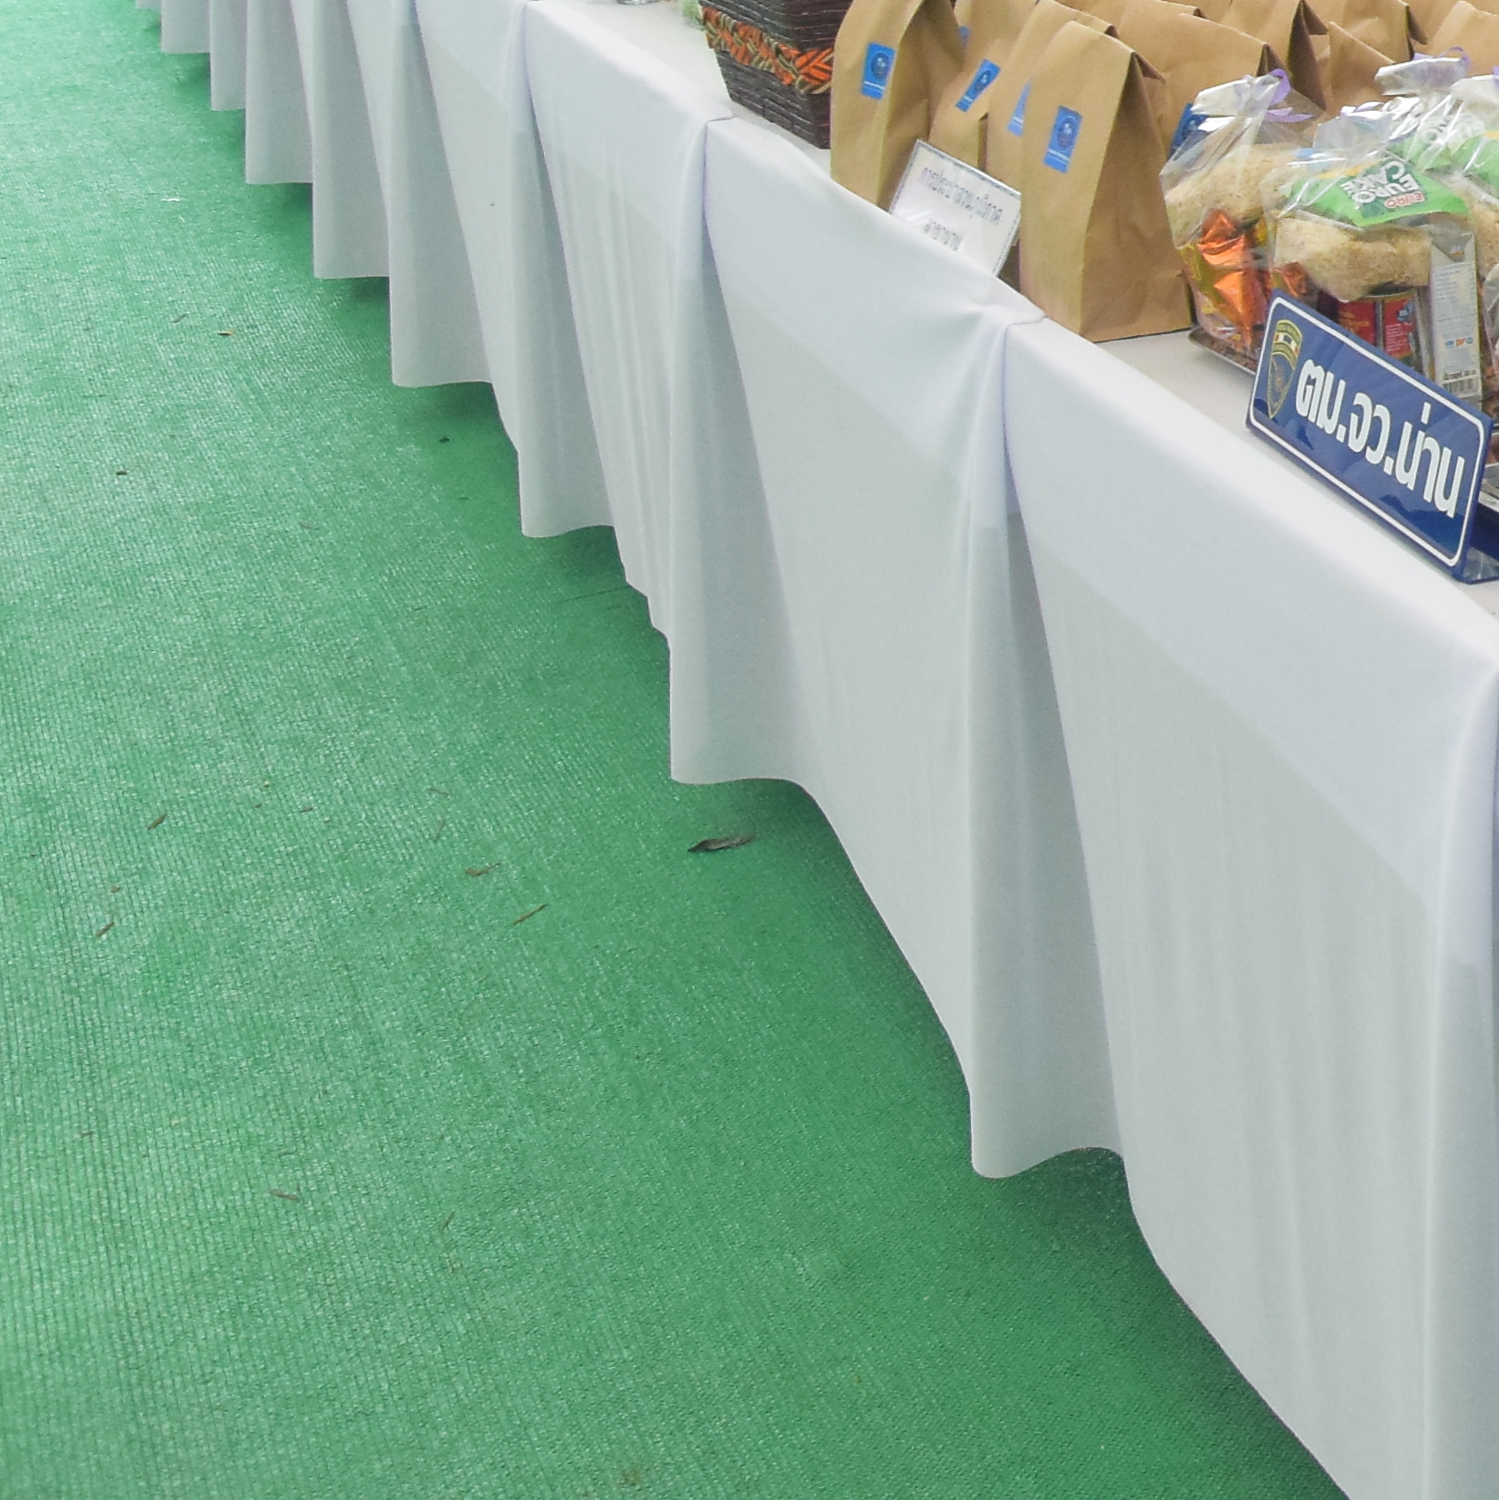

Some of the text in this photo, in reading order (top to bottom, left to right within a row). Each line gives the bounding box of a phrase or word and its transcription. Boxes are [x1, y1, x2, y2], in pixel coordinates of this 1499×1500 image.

[1351, 171, 1419, 205] EURO
[1295, 356, 1466, 520] ตม.จว.น่าน
